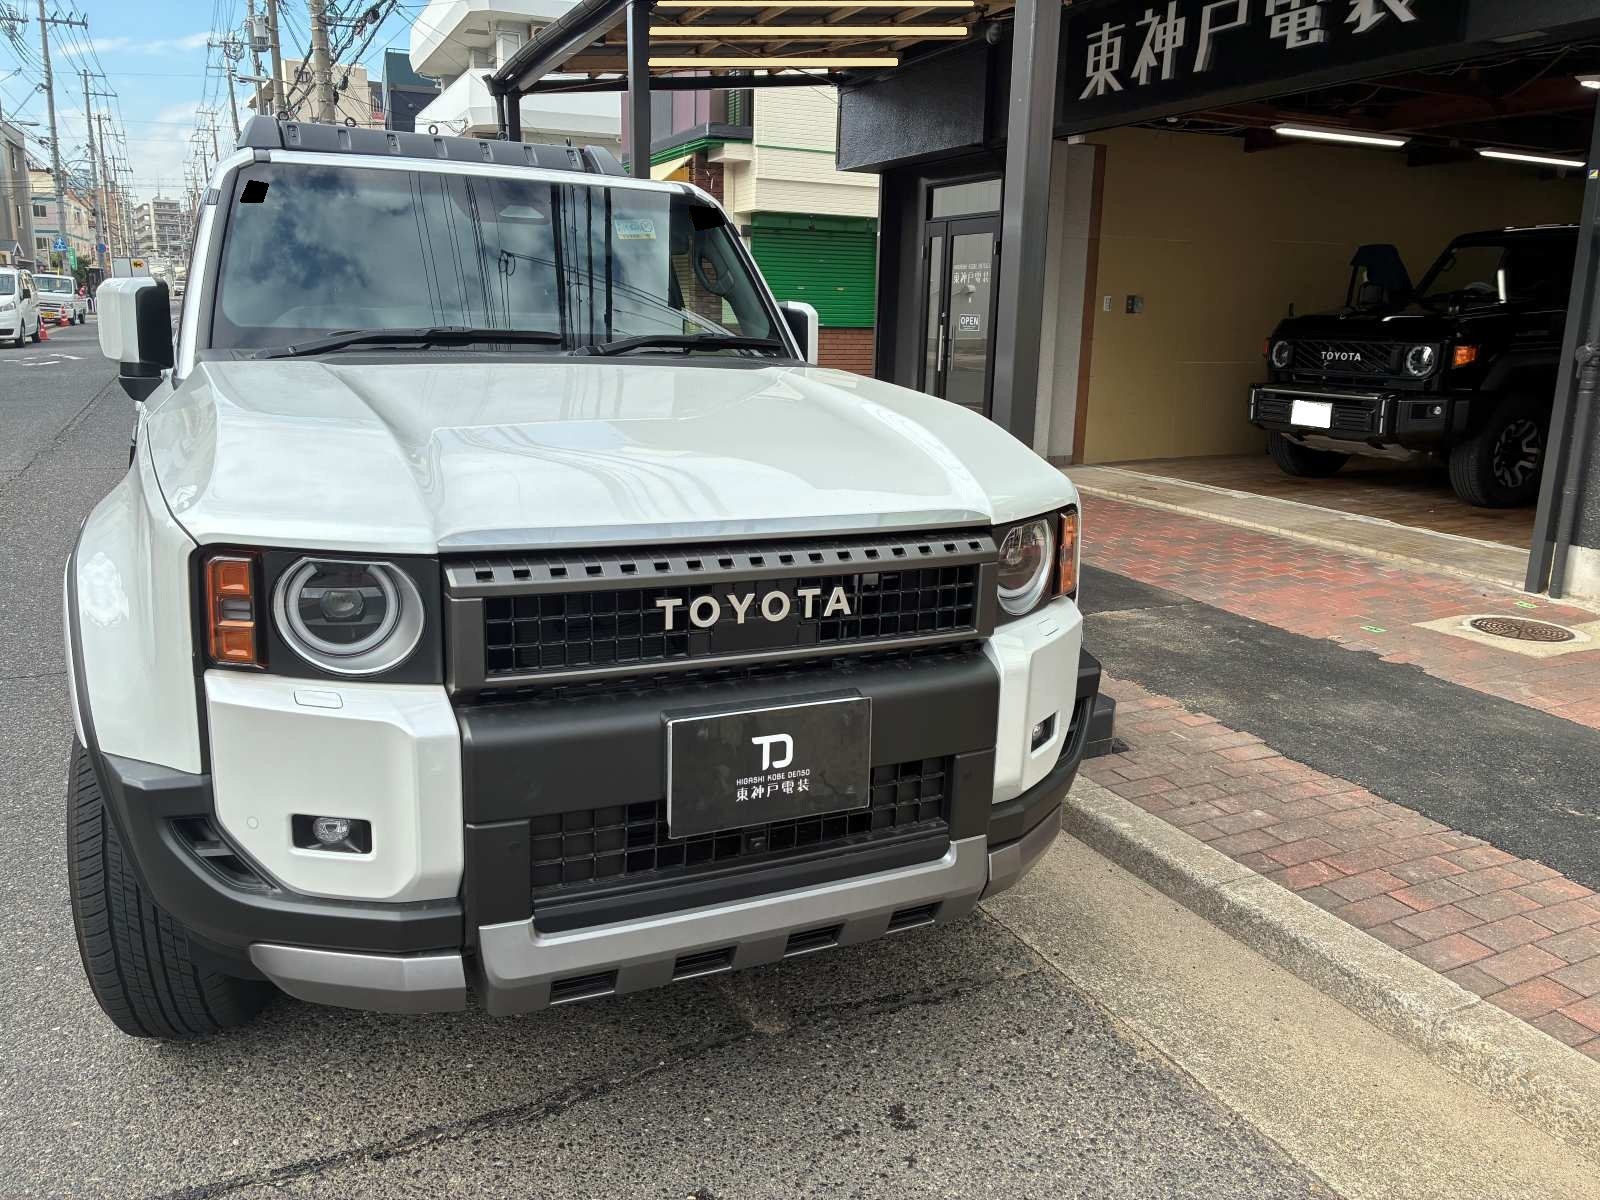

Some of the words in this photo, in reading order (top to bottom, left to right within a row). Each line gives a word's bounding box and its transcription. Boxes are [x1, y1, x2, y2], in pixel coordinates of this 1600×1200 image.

[960, 316, 979, 326] OPEN
[1321, 351, 1361, 361] TOYOTA
[655, 586, 852, 631] TOYOTA
[736, 775, 765, 786] HIGASHI
[767, 772, 786, 782] KOBE
[736, 778, 810, 803] 東神戸電装
